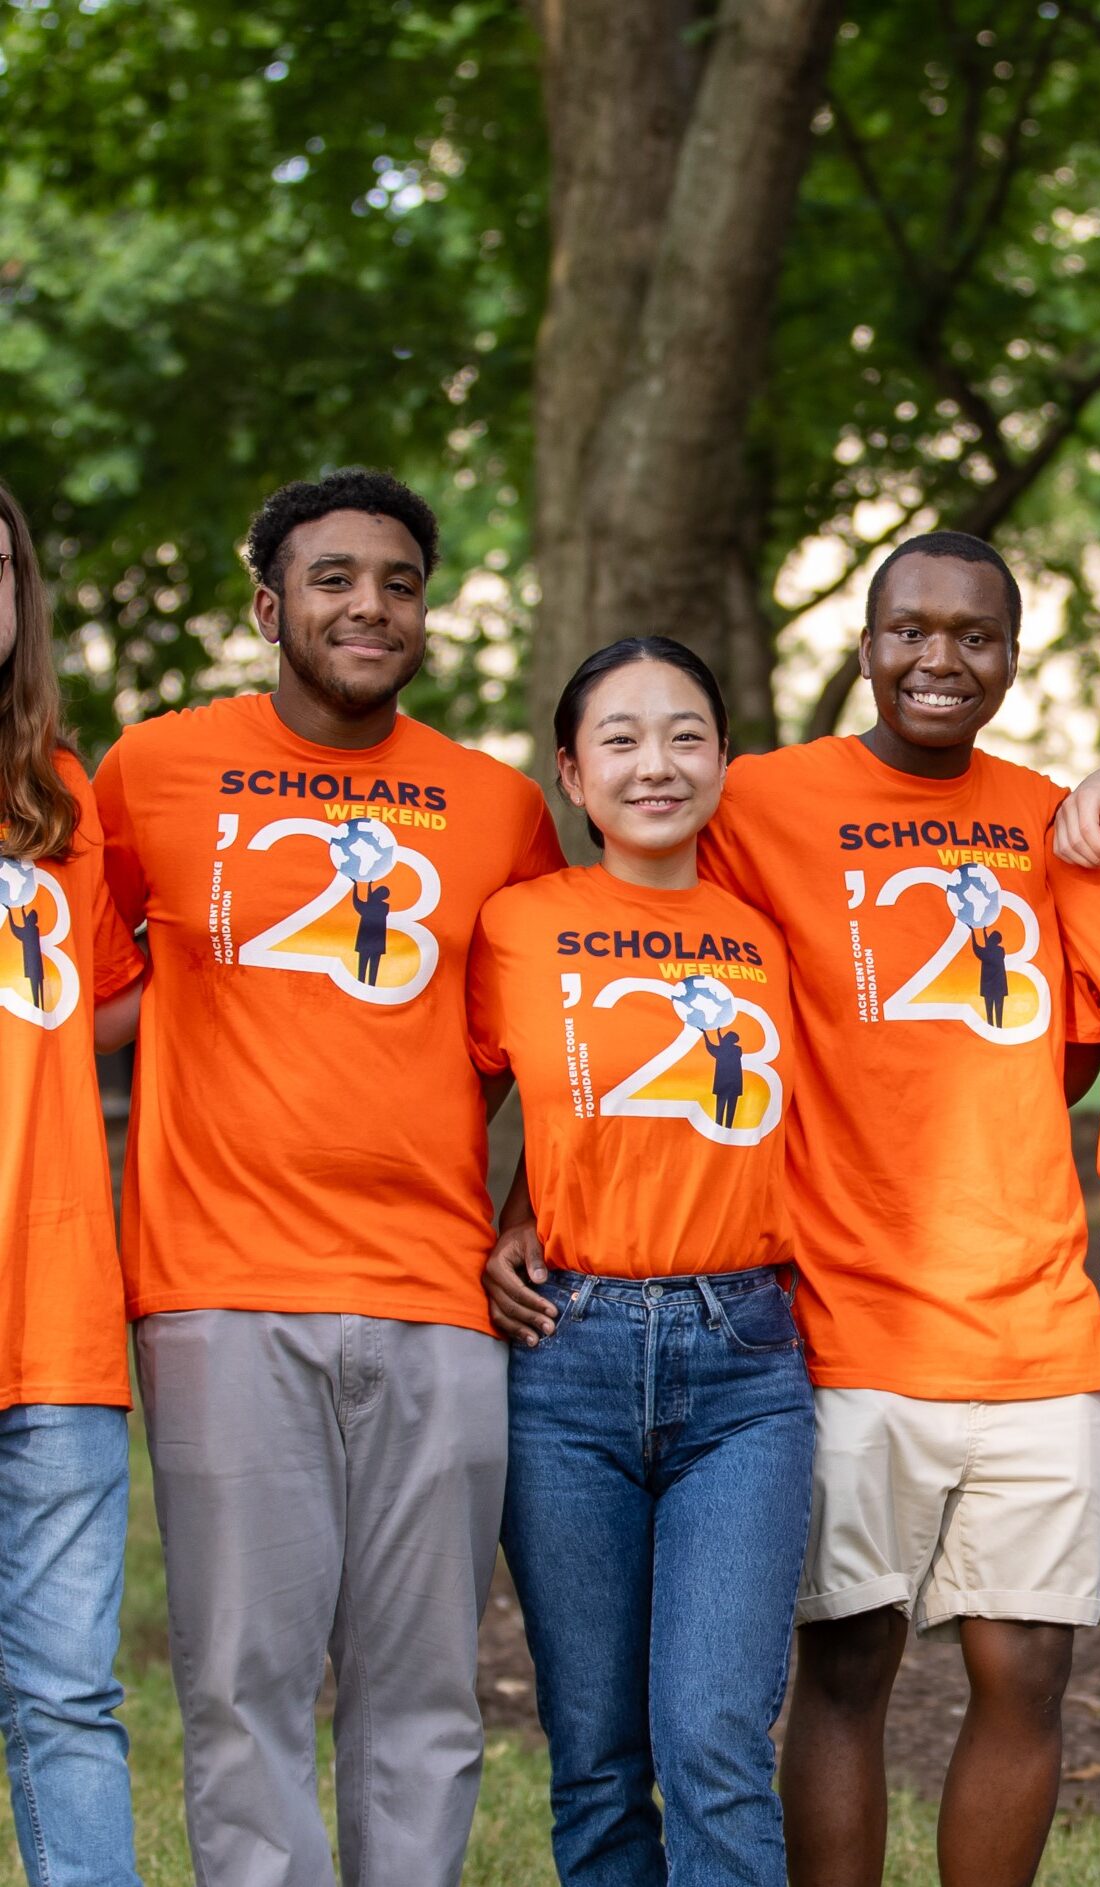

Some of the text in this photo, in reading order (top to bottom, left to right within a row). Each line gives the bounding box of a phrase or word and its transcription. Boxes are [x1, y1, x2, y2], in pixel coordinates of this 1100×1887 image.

[220, 770, 447, 811] SCHOLARS
[324, 803, 447, 831] WEEKEND
[839, 820, 1030, 852] SCHOLARS
[937, 849, 1032, 872] WEEKEND
[209, 861, 223, 964] JACK KENT COOKE
[221, 890, 233, 965] FOUNDATION
[556, 930, 763, 967] SCHOLARS
[658, 962, 768, 984] WEEKEND
[849, 920, 868, 1023] JACK KENT COOKE
[864, 948, 879, 1023] FOUNDATION
[564, 1017, 584, 1119] JACK KENT COOKE
[579, 1042, 595, 1118] FOUNDATION
